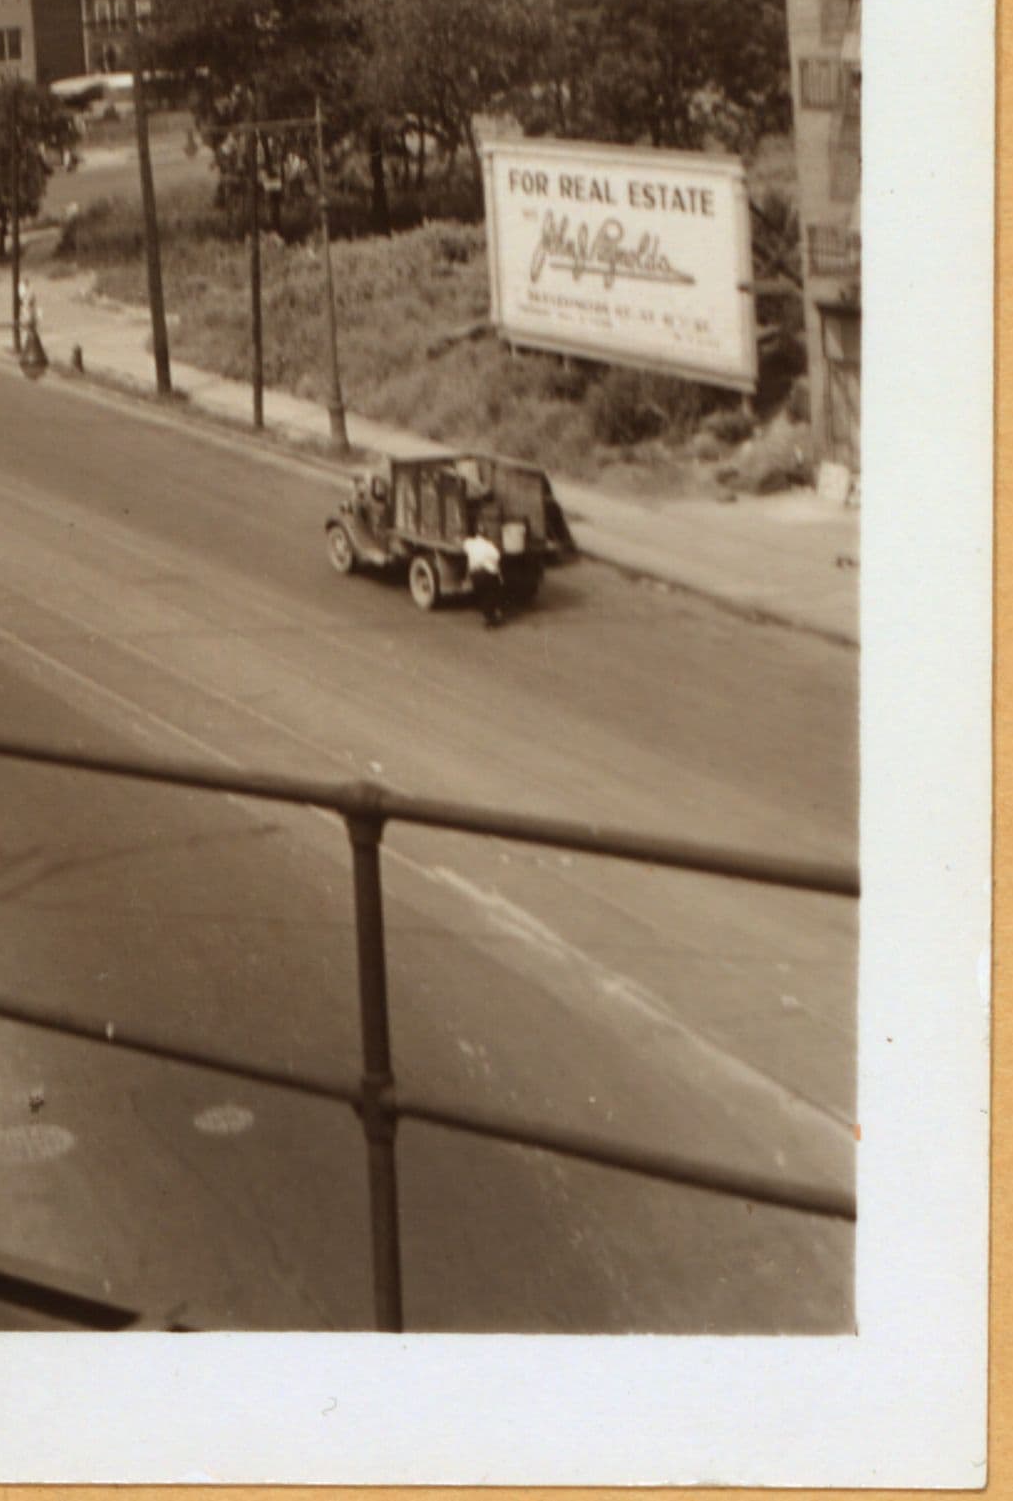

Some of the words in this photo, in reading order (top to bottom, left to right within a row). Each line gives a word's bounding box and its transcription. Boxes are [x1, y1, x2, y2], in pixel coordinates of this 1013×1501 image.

[508, 168, 549, 197] FOR
[558, 173, 617, 206] REAL
[627, 179, 716, 218] ESTATE
